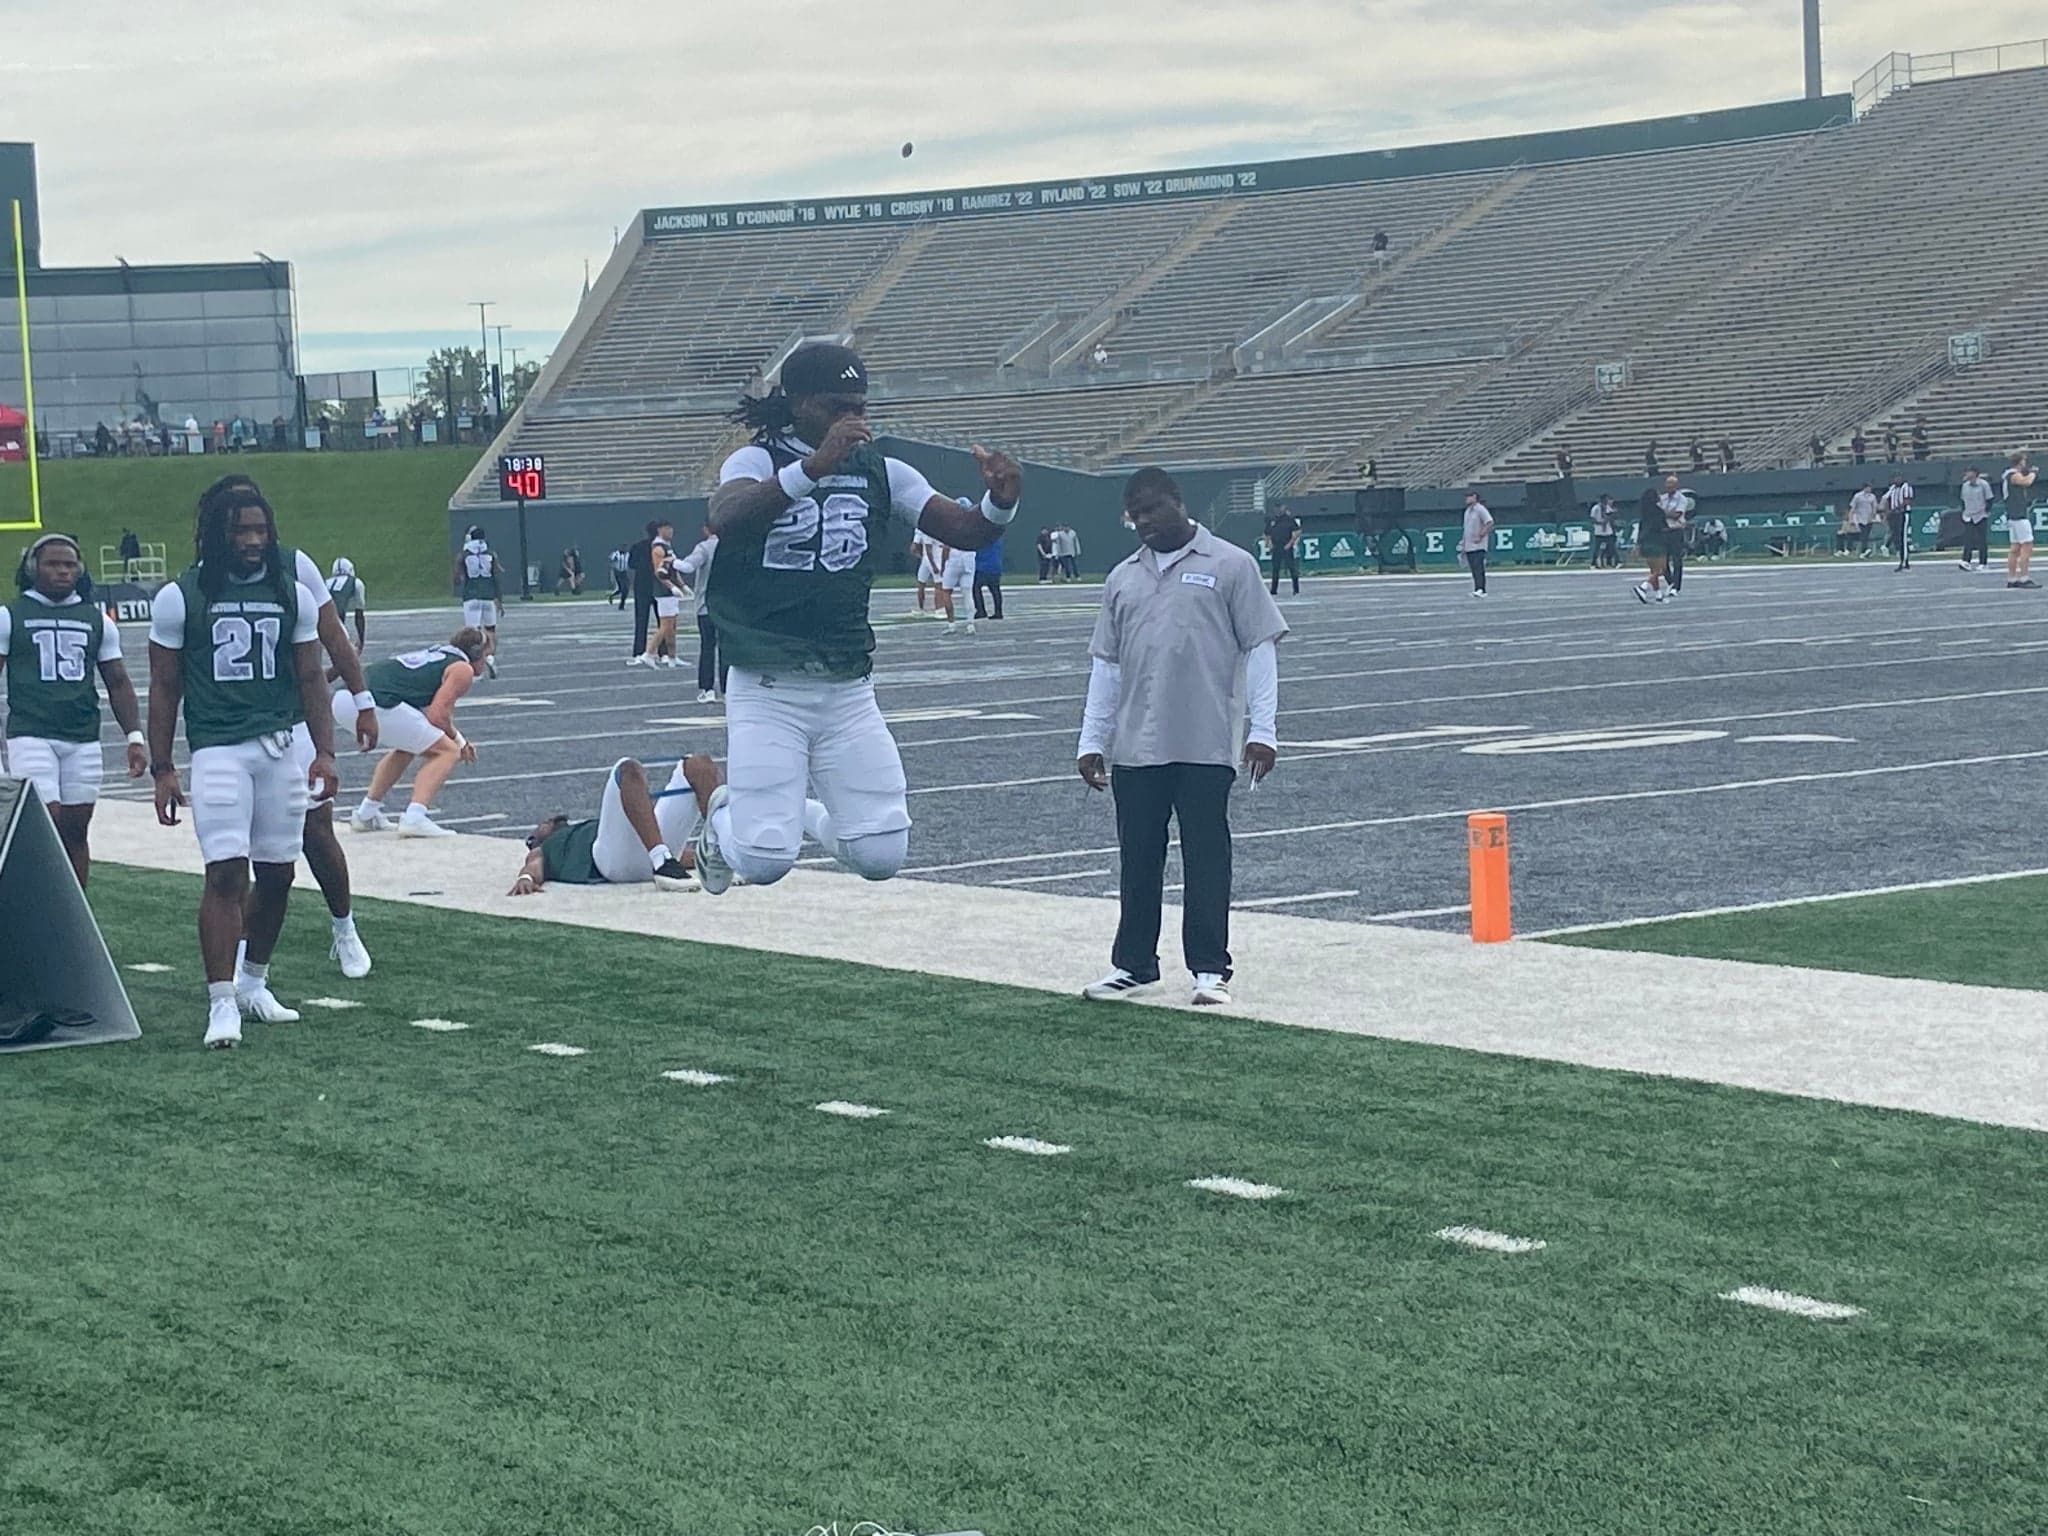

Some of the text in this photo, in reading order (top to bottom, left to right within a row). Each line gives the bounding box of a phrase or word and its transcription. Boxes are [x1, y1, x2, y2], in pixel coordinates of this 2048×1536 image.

[654, 211, 708, 230] JACKSON
[710, 211, 729, 227] '15
[736, 208, 795, 226] O'CONNOR
[824, 203, 862, 220] WYLIE
[890, 199, 934, 216] CROSBY
[961, 192, 1012, 210] RAMIREZ
[1014, 191, 1033, 205] '22
[1041, 186, 1085, 204] RYLAND
[1088, 184, 1107, 199] '22
[1113, 181, 1141, 197] SOW
[1144, 179, 1163, 194] '22
[1165, 173, 1234, 193] DRUMMOND
[1238, 171, 1257, 186] '22
[508, 472, 539, 497] 40
[762, 493, 870, 573] 26
[1302, 538, 1321, 560] E
[1426, 532, 1443, 553] E
[1495, 529, 1513, 550] E
[32, 630, 88, 681] 15
[212, 617, 281, 682] 21
